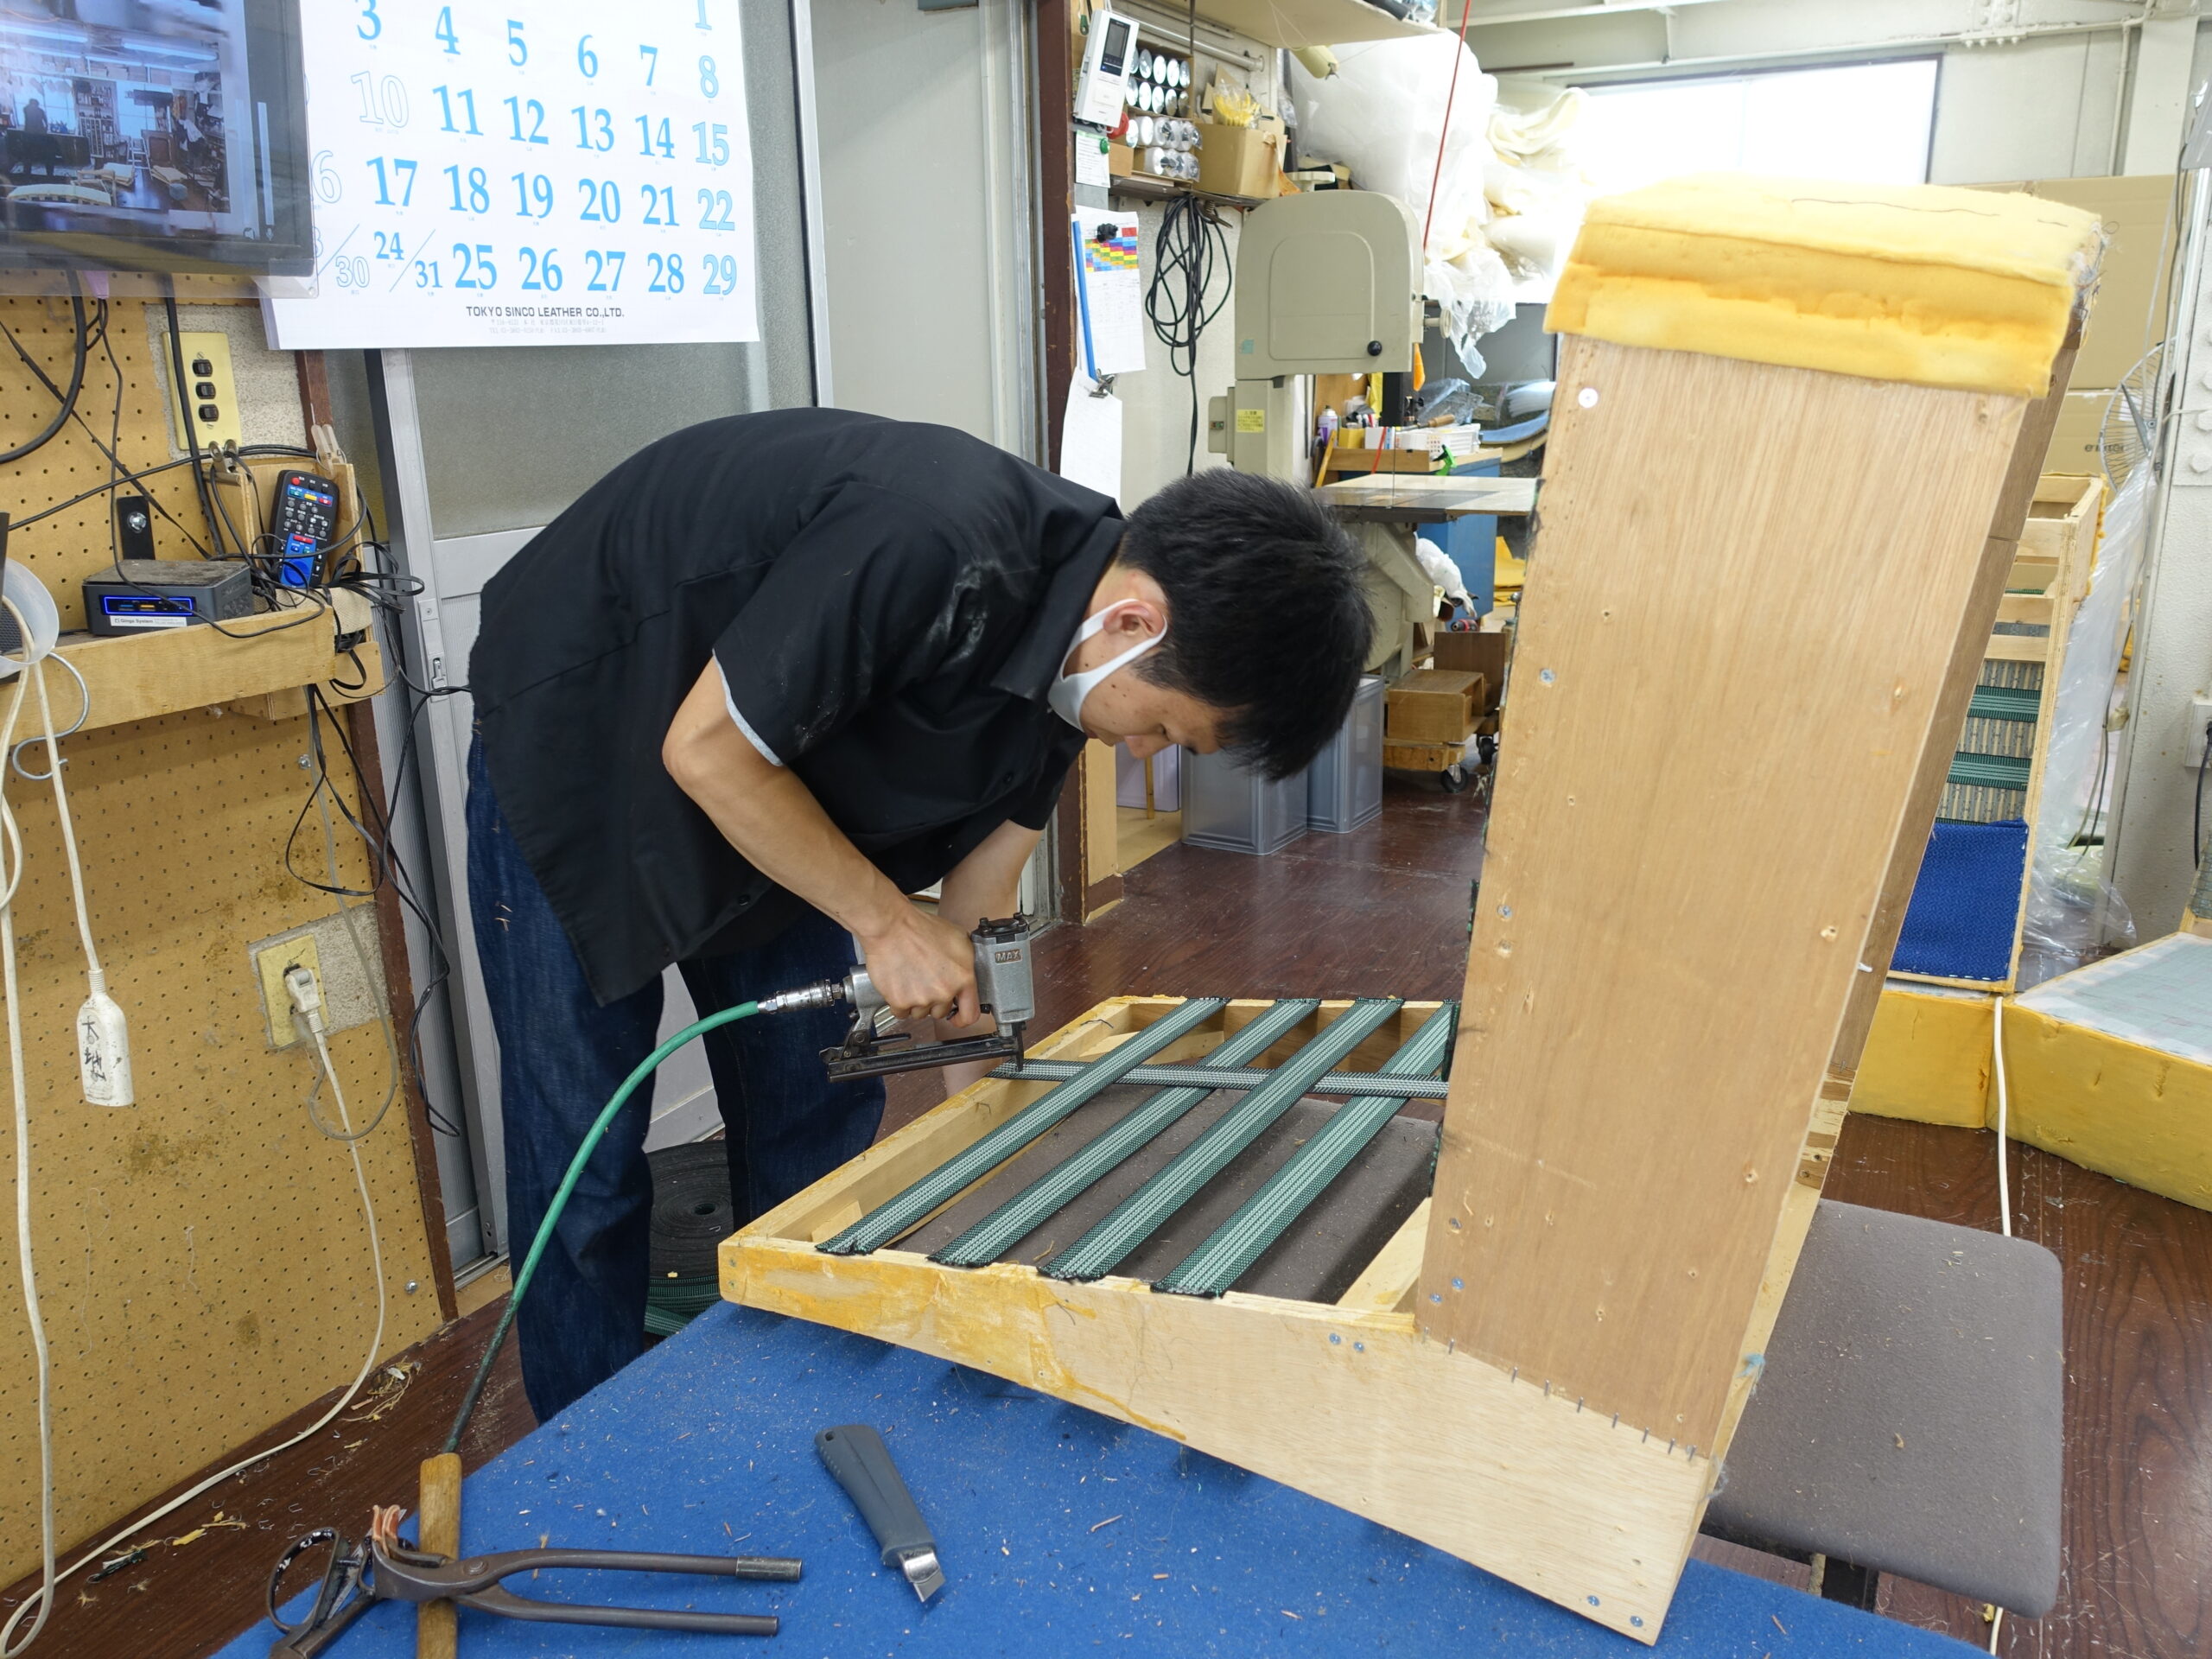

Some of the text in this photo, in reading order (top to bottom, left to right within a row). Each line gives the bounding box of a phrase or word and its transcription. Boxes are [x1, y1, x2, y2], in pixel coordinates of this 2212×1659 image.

[695, 0, 712, 30] 1
[356, 0, 719, 99] 3 4 5 6 7 8
[350, 71, 730, 166] 10 11 12 13 14 15
[311, 149, 735, 231] 6 17 18 19 20 21 22
[373, 231, 404, 260] 24
[335, 243, 737, 296] 30 31 25 26 27 28 29
[467, 306, 625, 318] TOKYO SINCO LEATHER CO.,LTD.
[995, 950, 1020, 962] MAX
